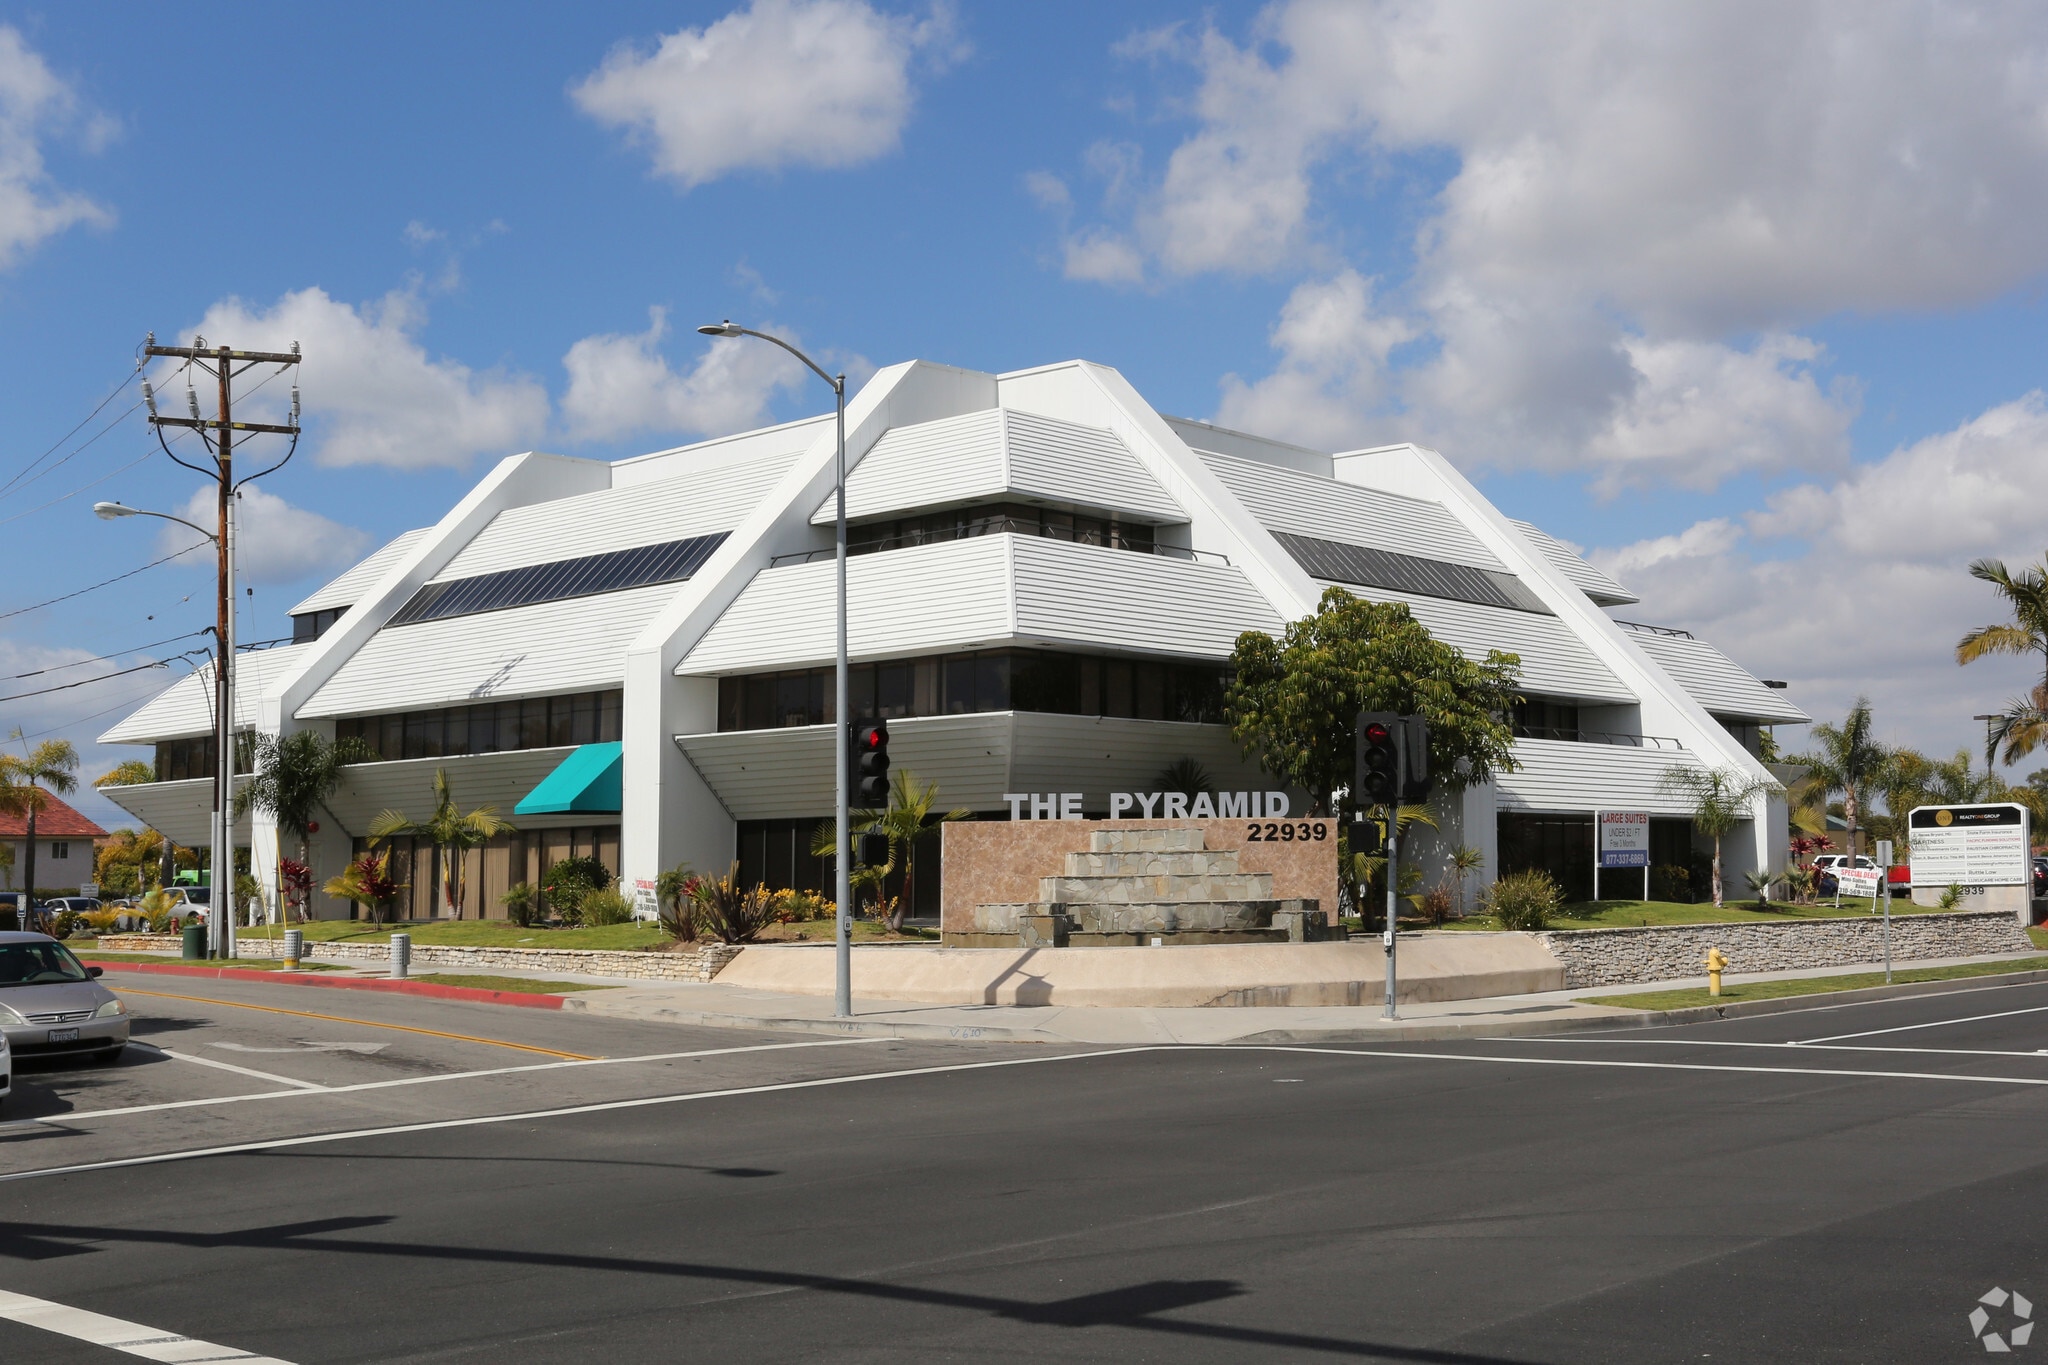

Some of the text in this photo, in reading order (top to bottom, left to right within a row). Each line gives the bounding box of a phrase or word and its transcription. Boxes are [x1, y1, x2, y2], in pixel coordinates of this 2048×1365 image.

[1002, 791, 1290, 820] THE PYRAMID
[1602, 813, 1647, 824] LARGE SUITES
[1247, 823, 1327, 842] 22939
[1609, 828, 1625, 837] UNDER
[1841, 869, 1878, 879] SPECIAL DEALS
[1954, 886, 1985, 895] 2939
